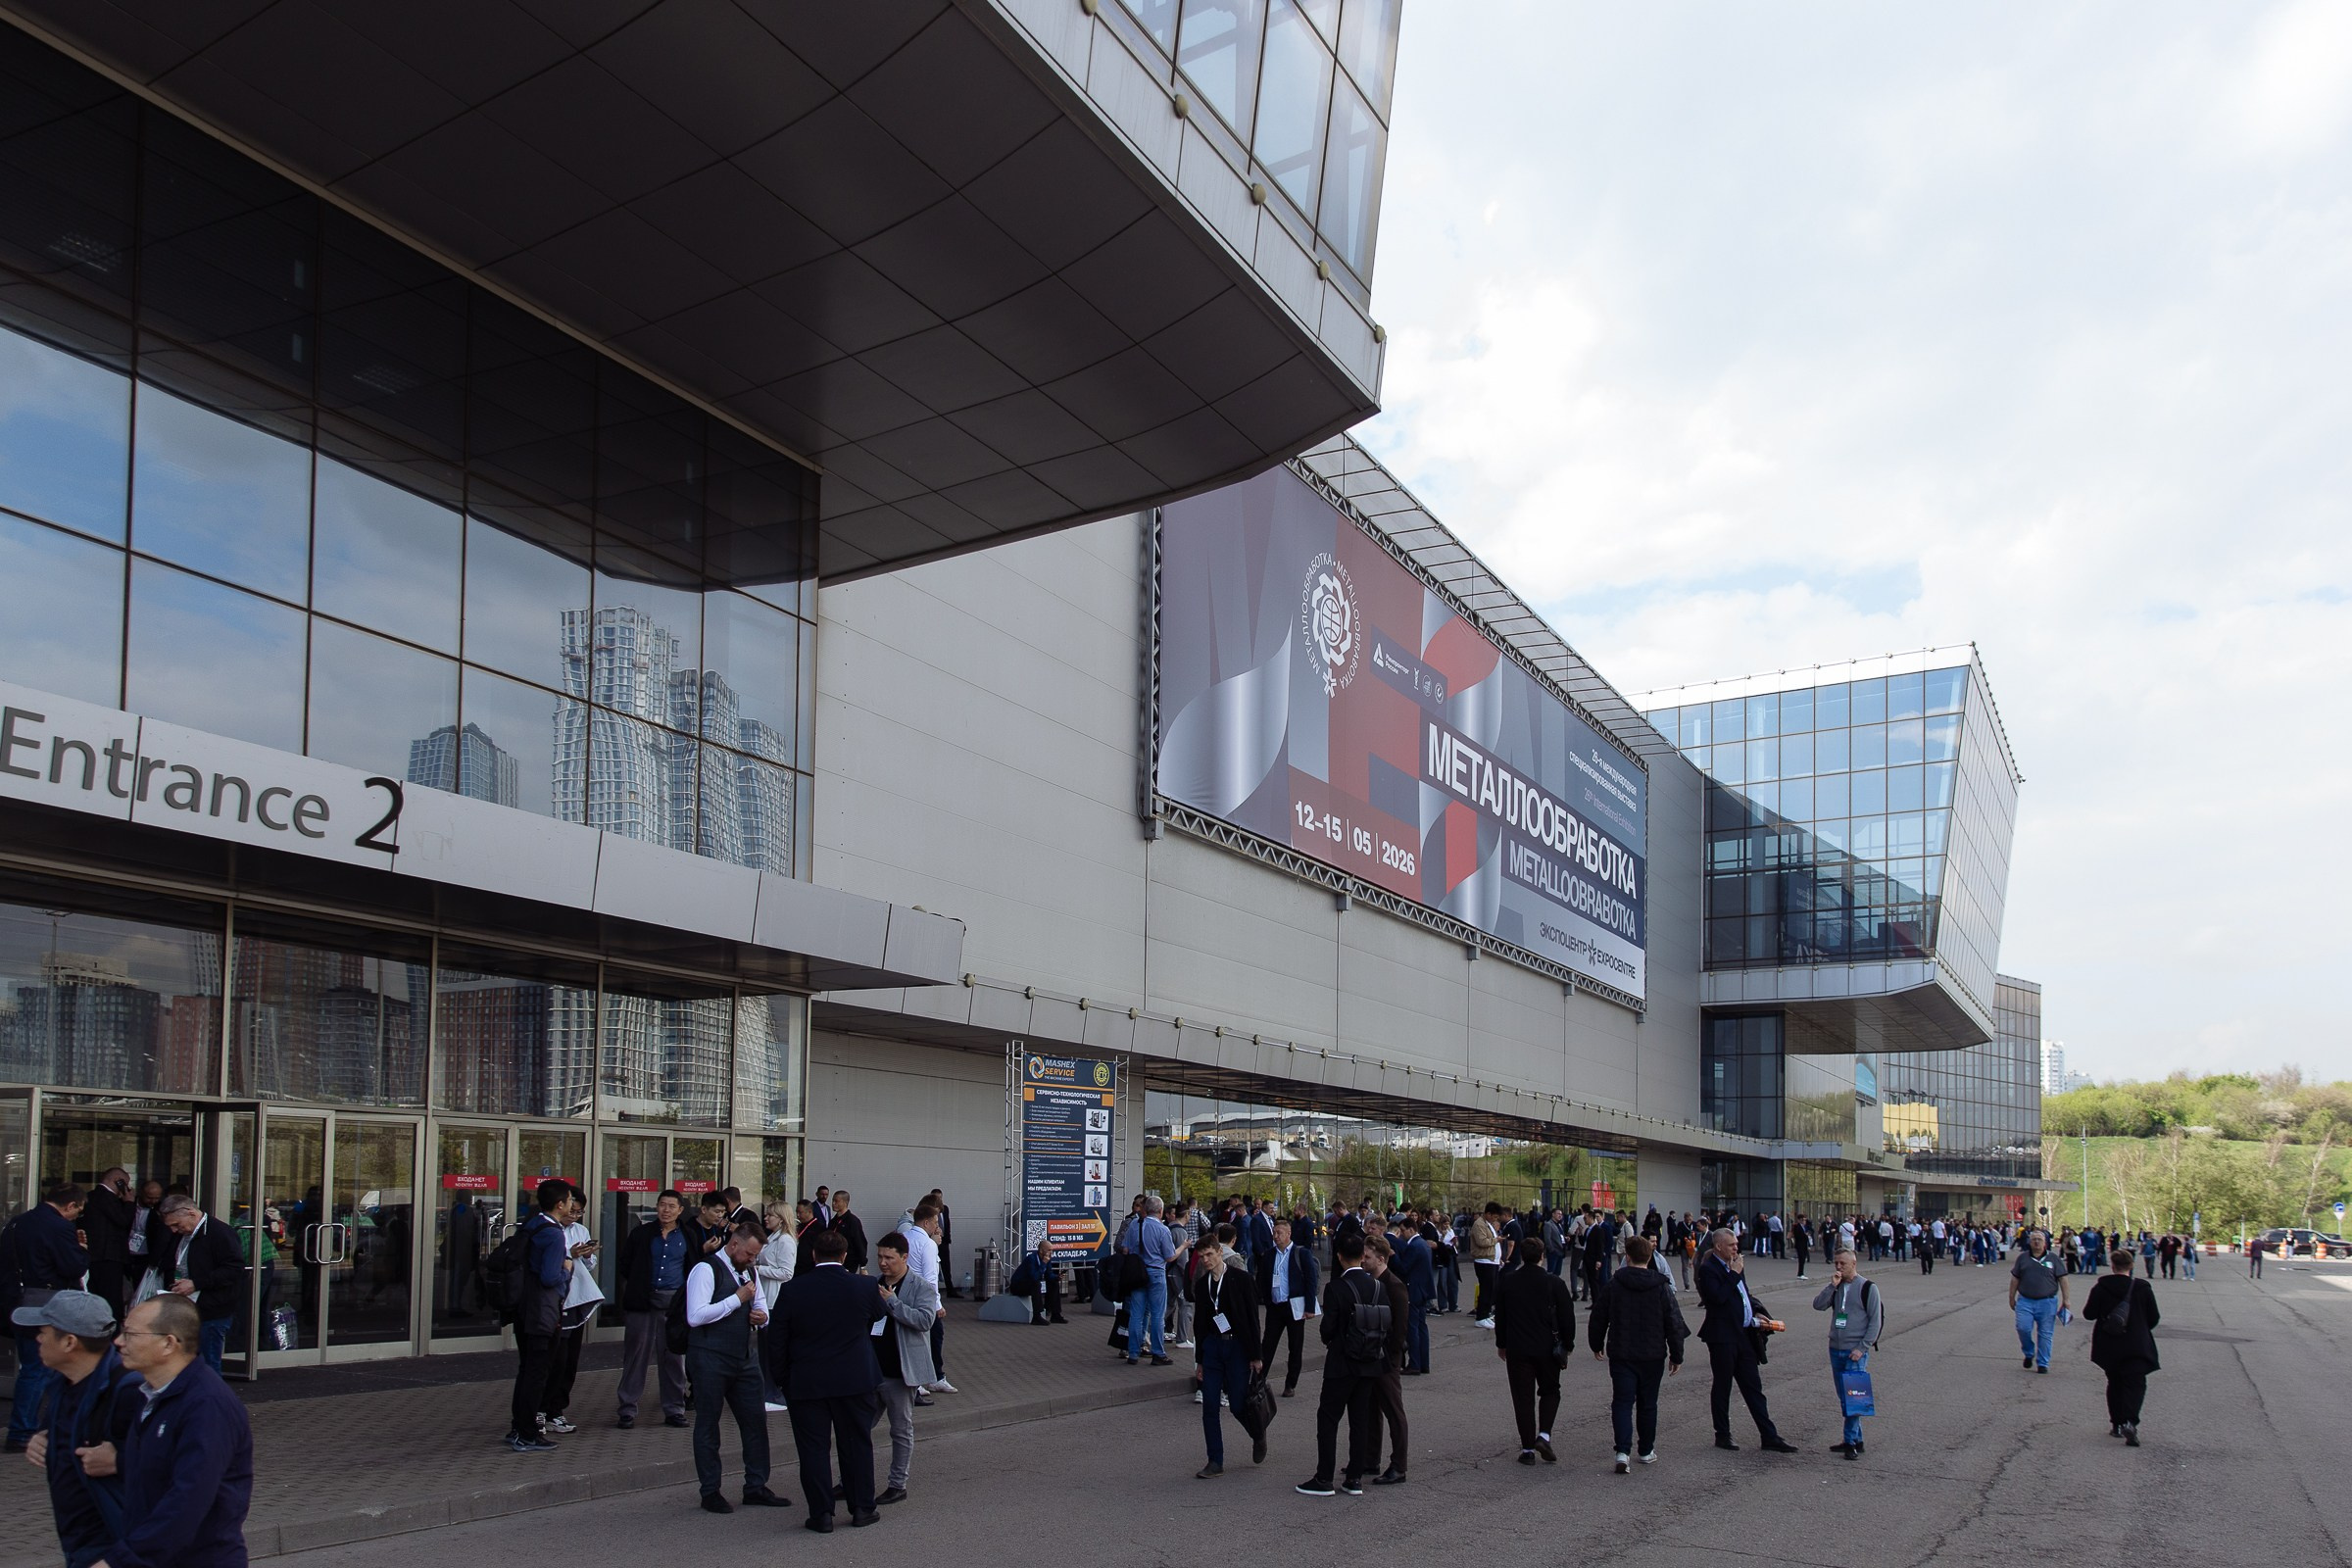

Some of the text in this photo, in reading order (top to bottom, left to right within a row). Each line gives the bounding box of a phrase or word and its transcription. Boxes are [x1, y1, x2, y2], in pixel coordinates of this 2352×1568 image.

[0, 706, 405, 855] Entrance 2
[1570, 751, 1637, 812] специализированная выставка
[1602, 760, 1637, 796] международная
[1429, 722, 1637, 900] МЕТАЛЛООБРАБОТКА
[1593, 795, 1618, 821] International
[1618, 813, 1637, 837] Exhibition
[1353, 826, 1372, 856] 05
[1382, 841, 1415, 876] 2026
[1509, 840, 1637, 940] METALLOOBRABOTKA
[1540, 921, 1587, 956] ЭКСПОЦЕНТР
[1596, 949, 1636, 979] EXPOCENTRE
[1045, 1059, 1075, 1069] MASHEX
[1045, 1067, 1075, 1077] SERVICE
[1036, 1089, 1101, 1099] СЕРВИСНО-ТЕХНОЛОГИЧЕСКАЯ
